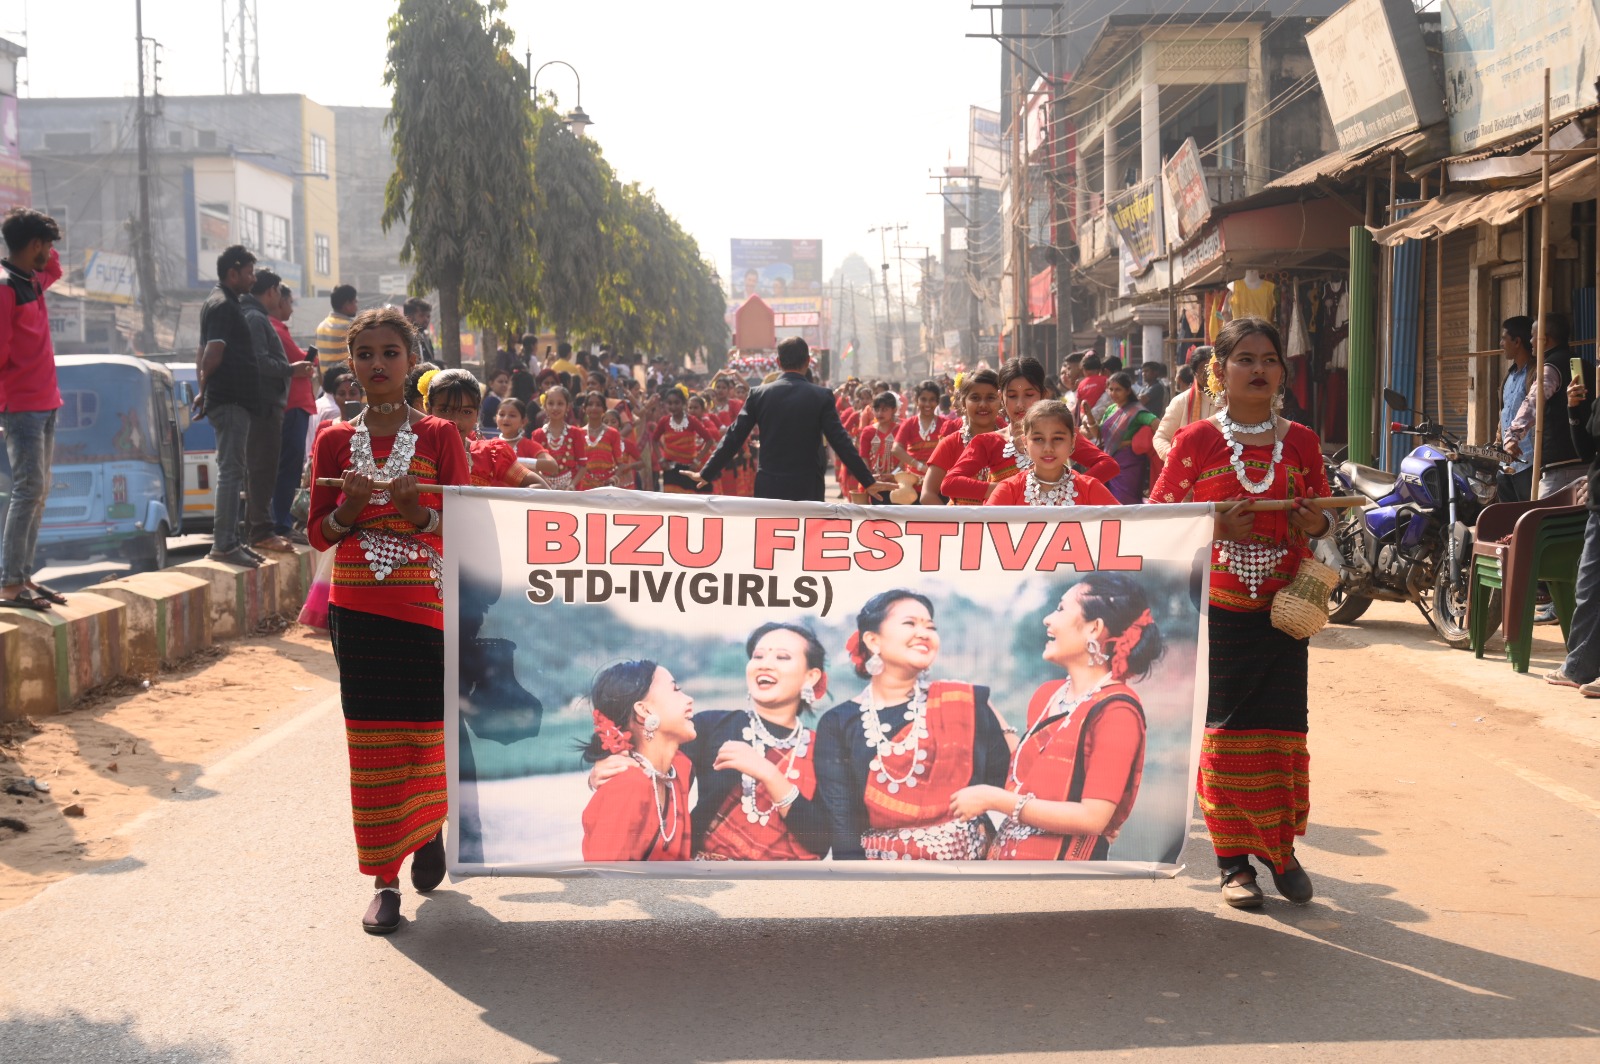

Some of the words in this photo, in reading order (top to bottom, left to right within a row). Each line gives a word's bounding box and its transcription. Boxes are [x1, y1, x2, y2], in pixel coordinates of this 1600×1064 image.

[1481, 119, 1494, 136] Road
[526, 509, 723, 567] BIZU
[753, 517, 1143, 572] FESTIVAL
[526, 569, 834, 616] STD-IV(GIRLS)
